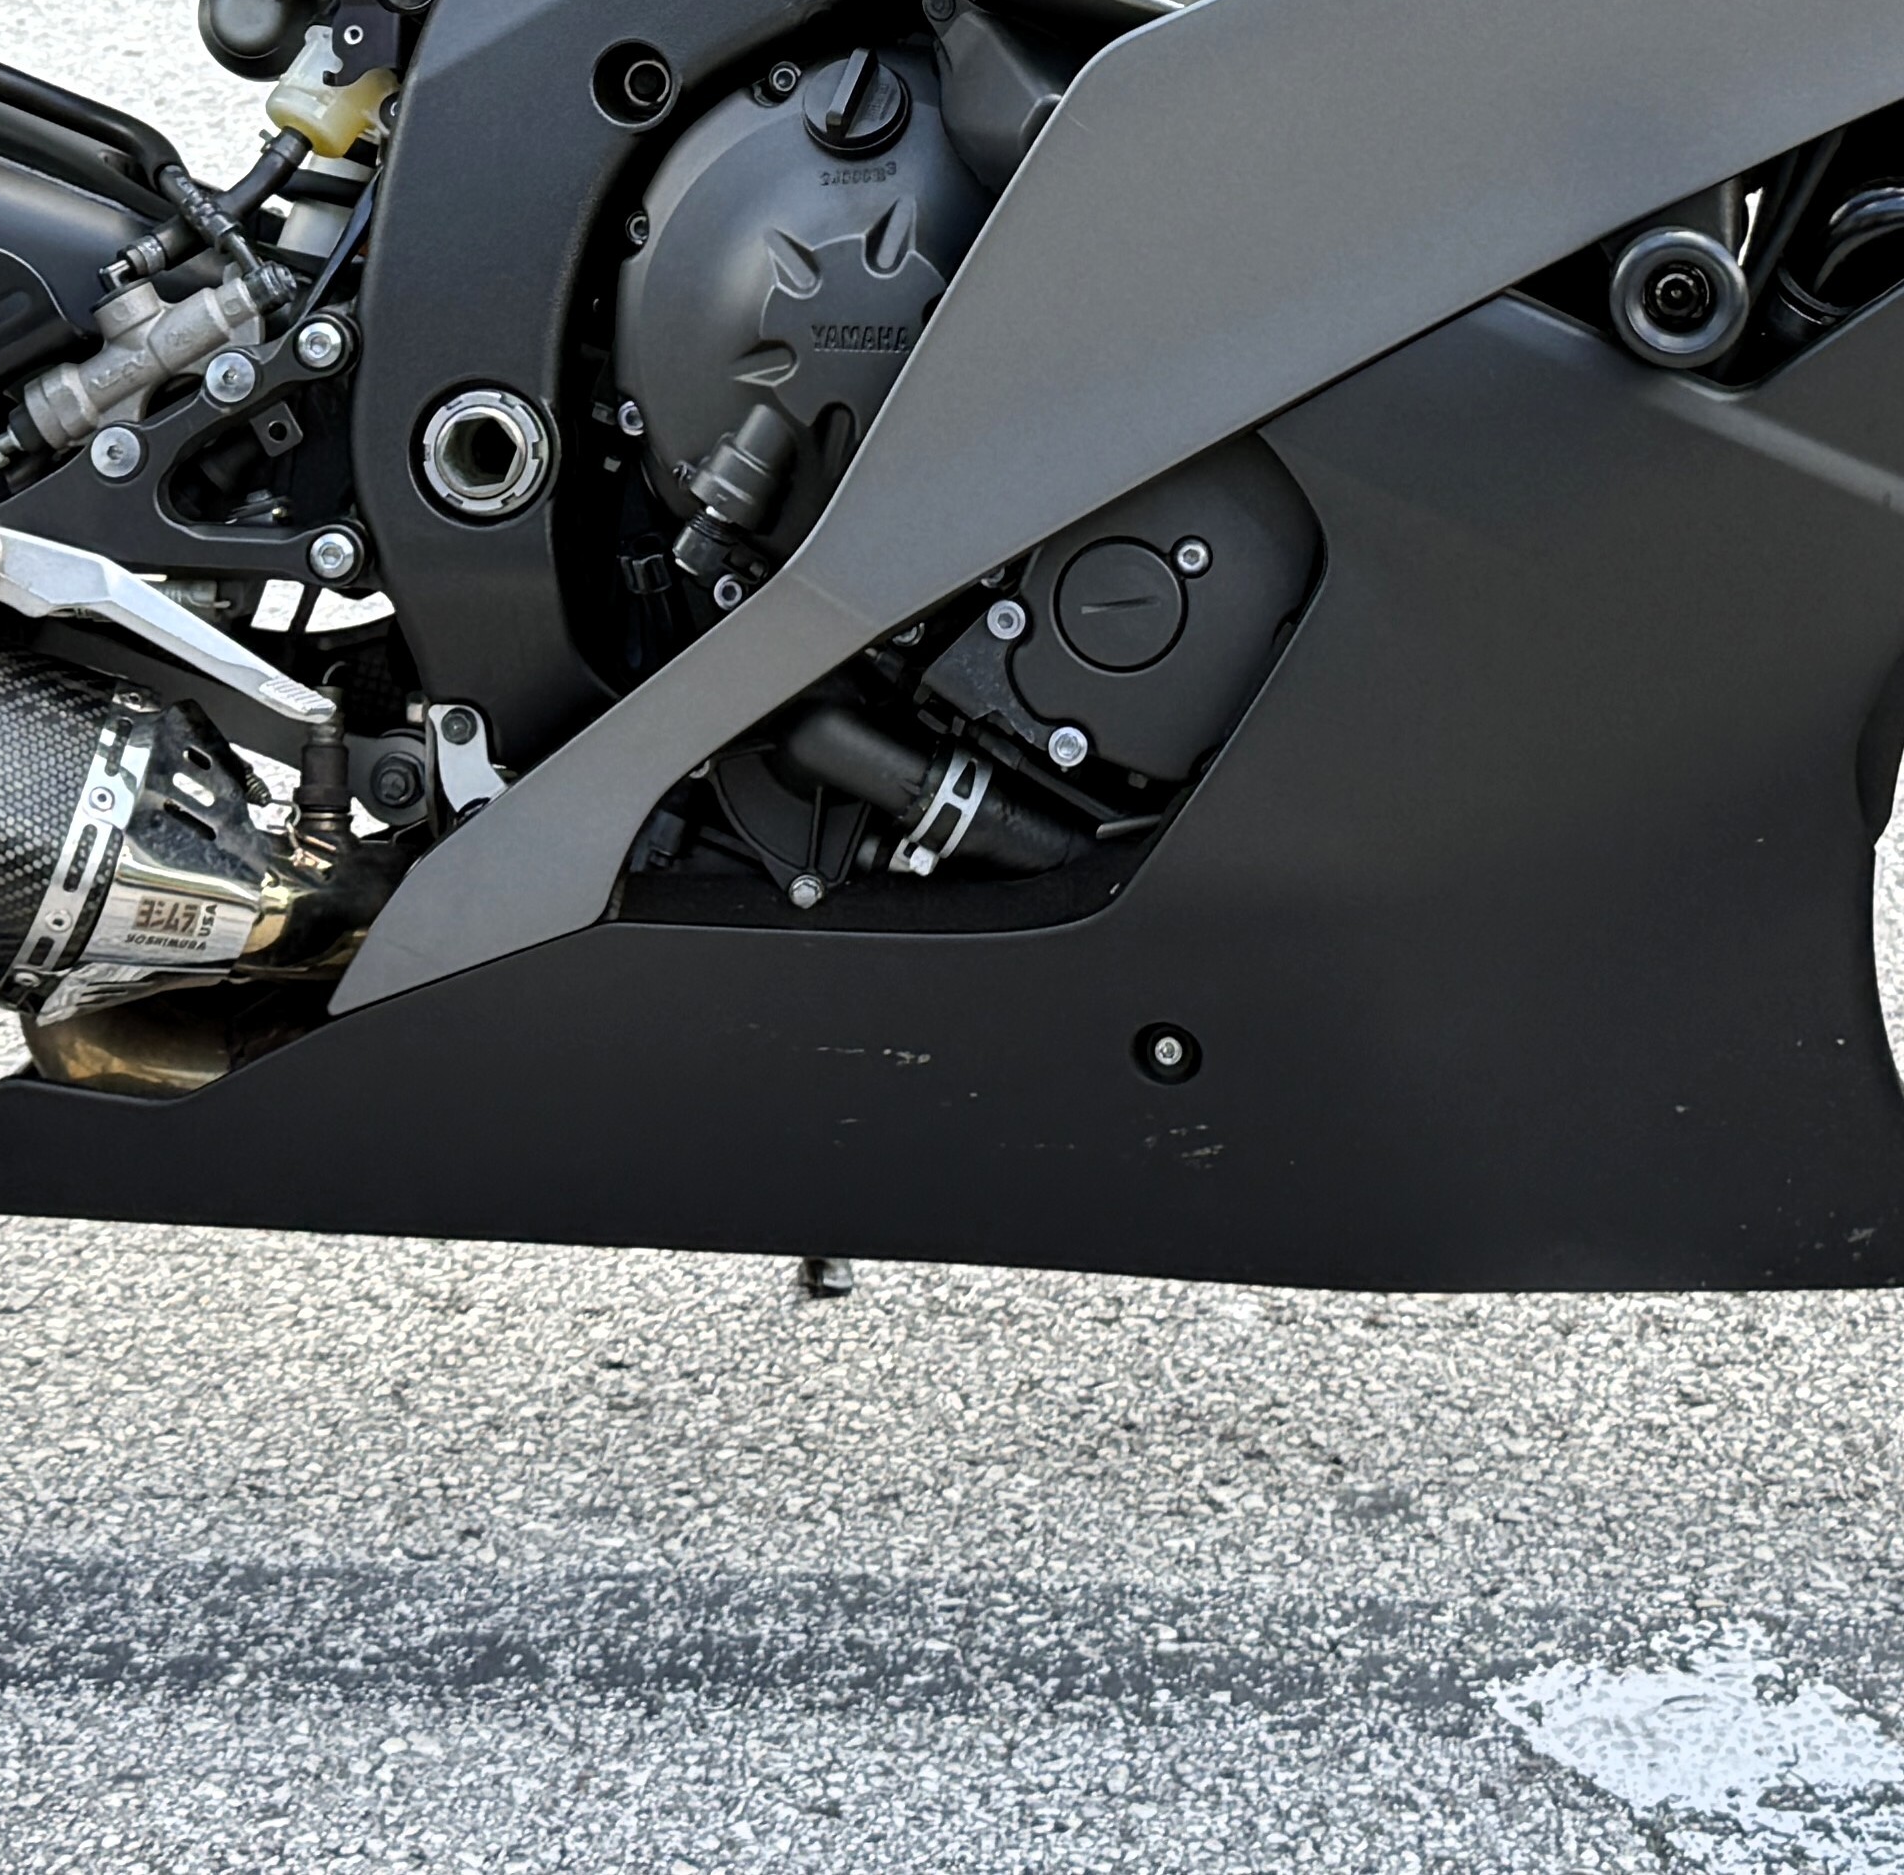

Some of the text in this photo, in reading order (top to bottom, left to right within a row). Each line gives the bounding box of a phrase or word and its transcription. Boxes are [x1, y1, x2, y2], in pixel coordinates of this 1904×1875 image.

[810, 324, 909, 352] YAMAHA
[197, 903, 218, 938] USA
[124, 933, 208, 951] YOSHIMURA
